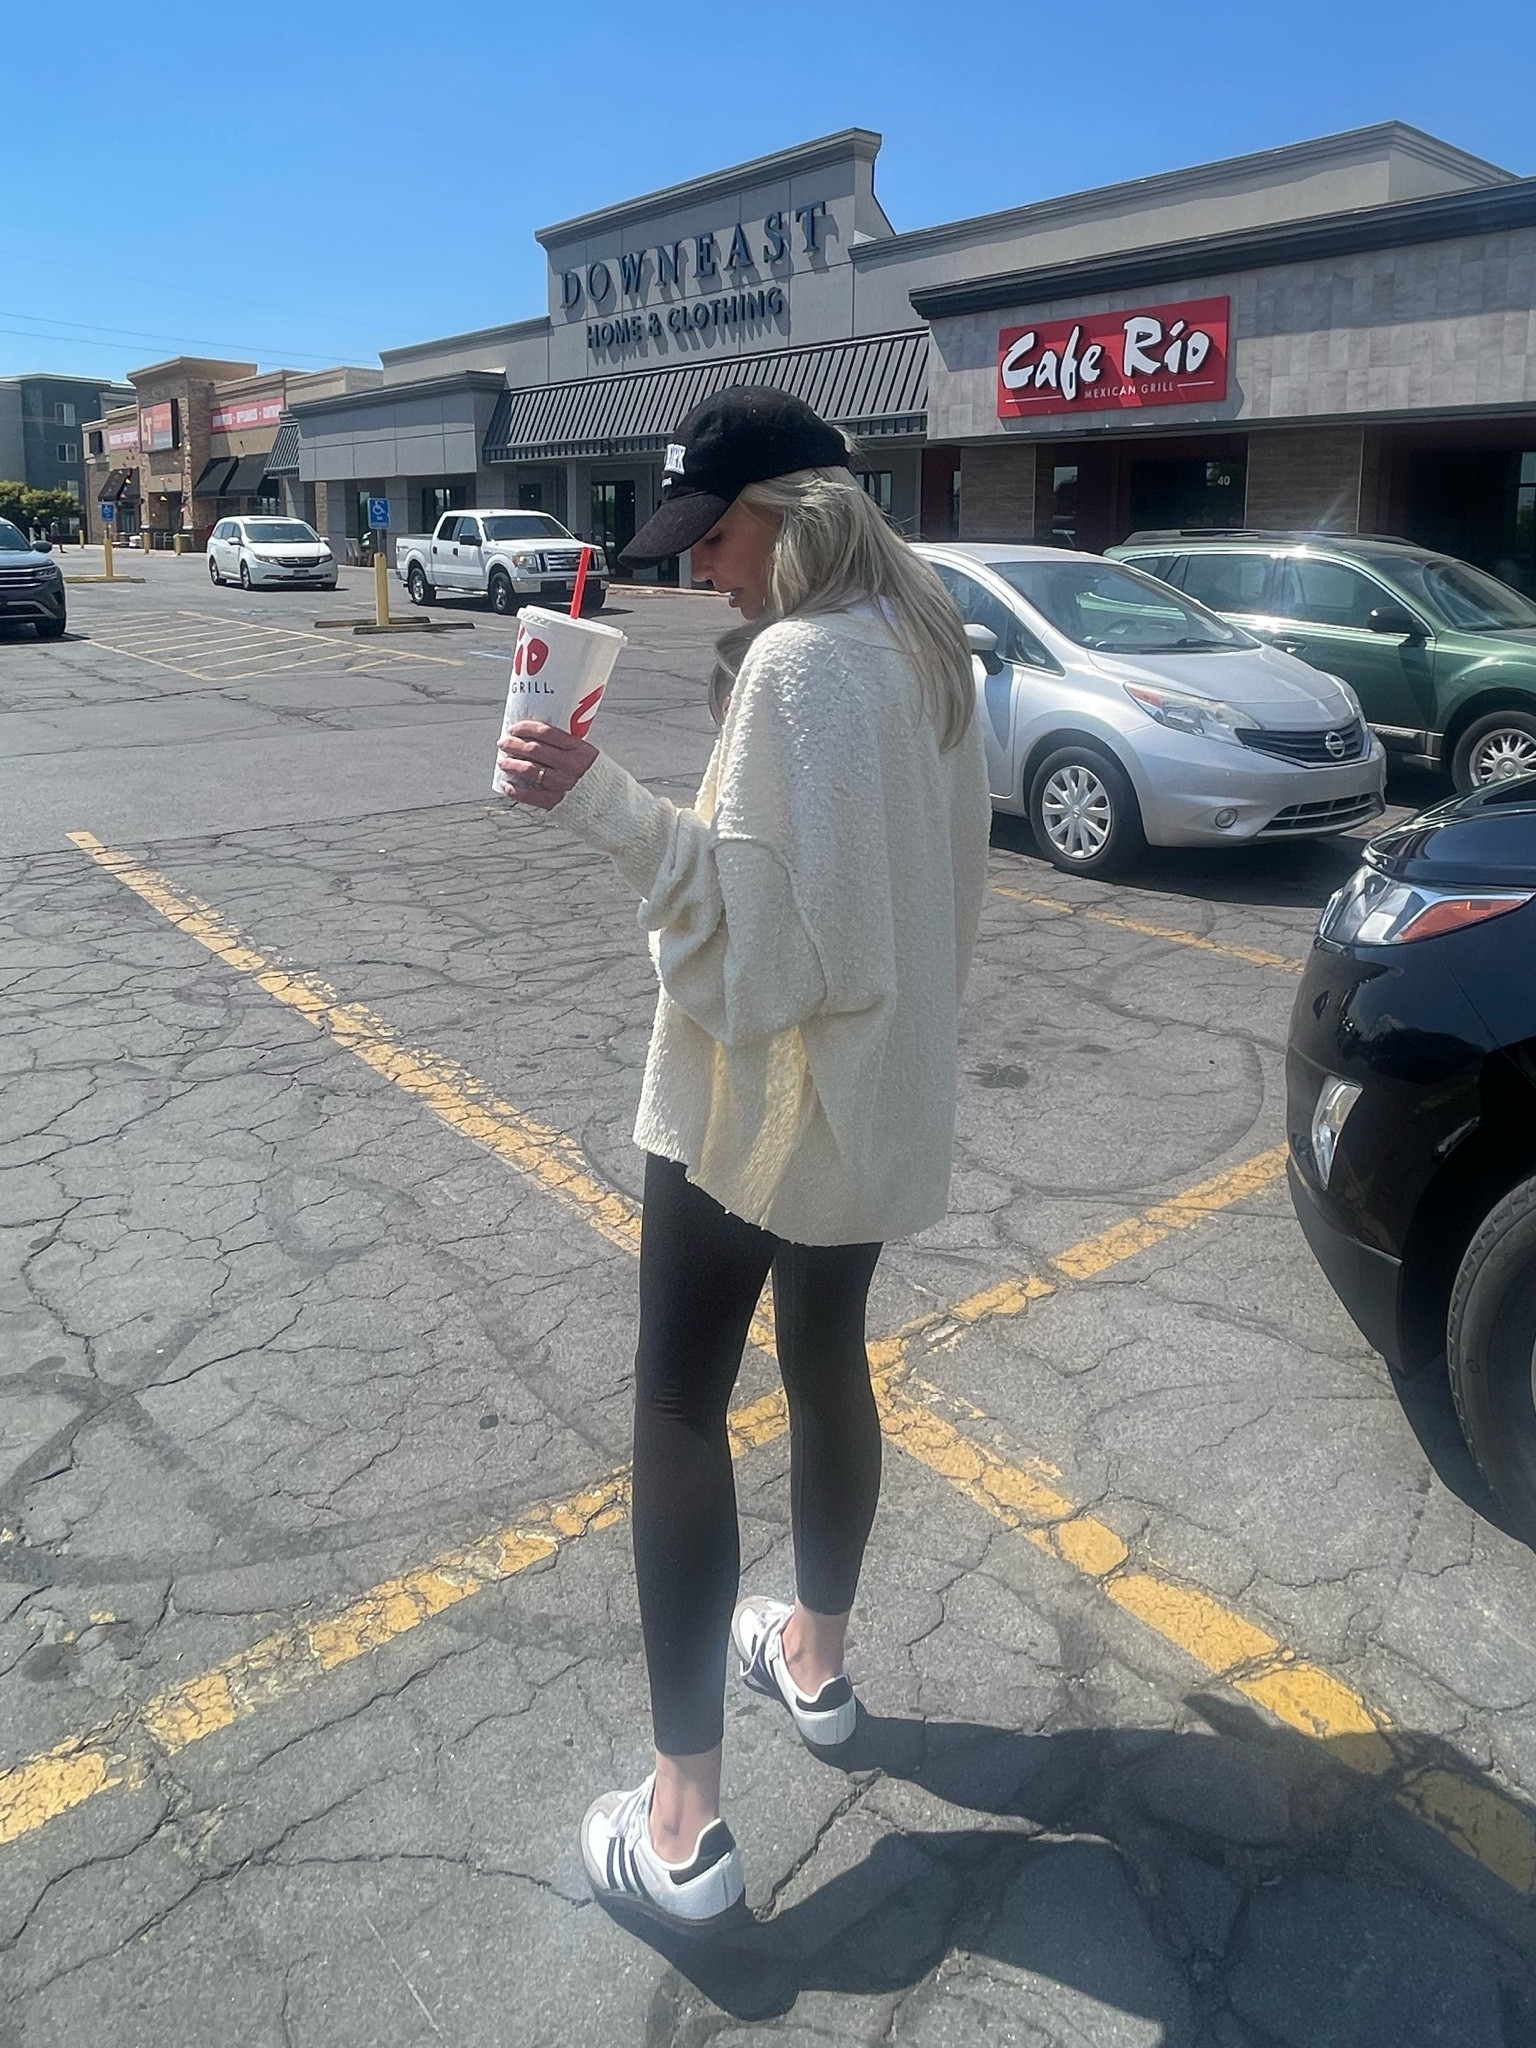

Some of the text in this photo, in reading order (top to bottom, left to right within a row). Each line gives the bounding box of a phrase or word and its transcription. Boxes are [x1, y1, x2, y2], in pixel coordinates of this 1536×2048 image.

[559, 201, 826, 309] DOWNEAST
[587, 286, 783, 348] HOME & CLOTHING
[1001, 325, 1103, 401] Cafe
[1084, 382, 1174, 398] MEXICAN GRILL
[1217, 475, 1231, 486] 40
